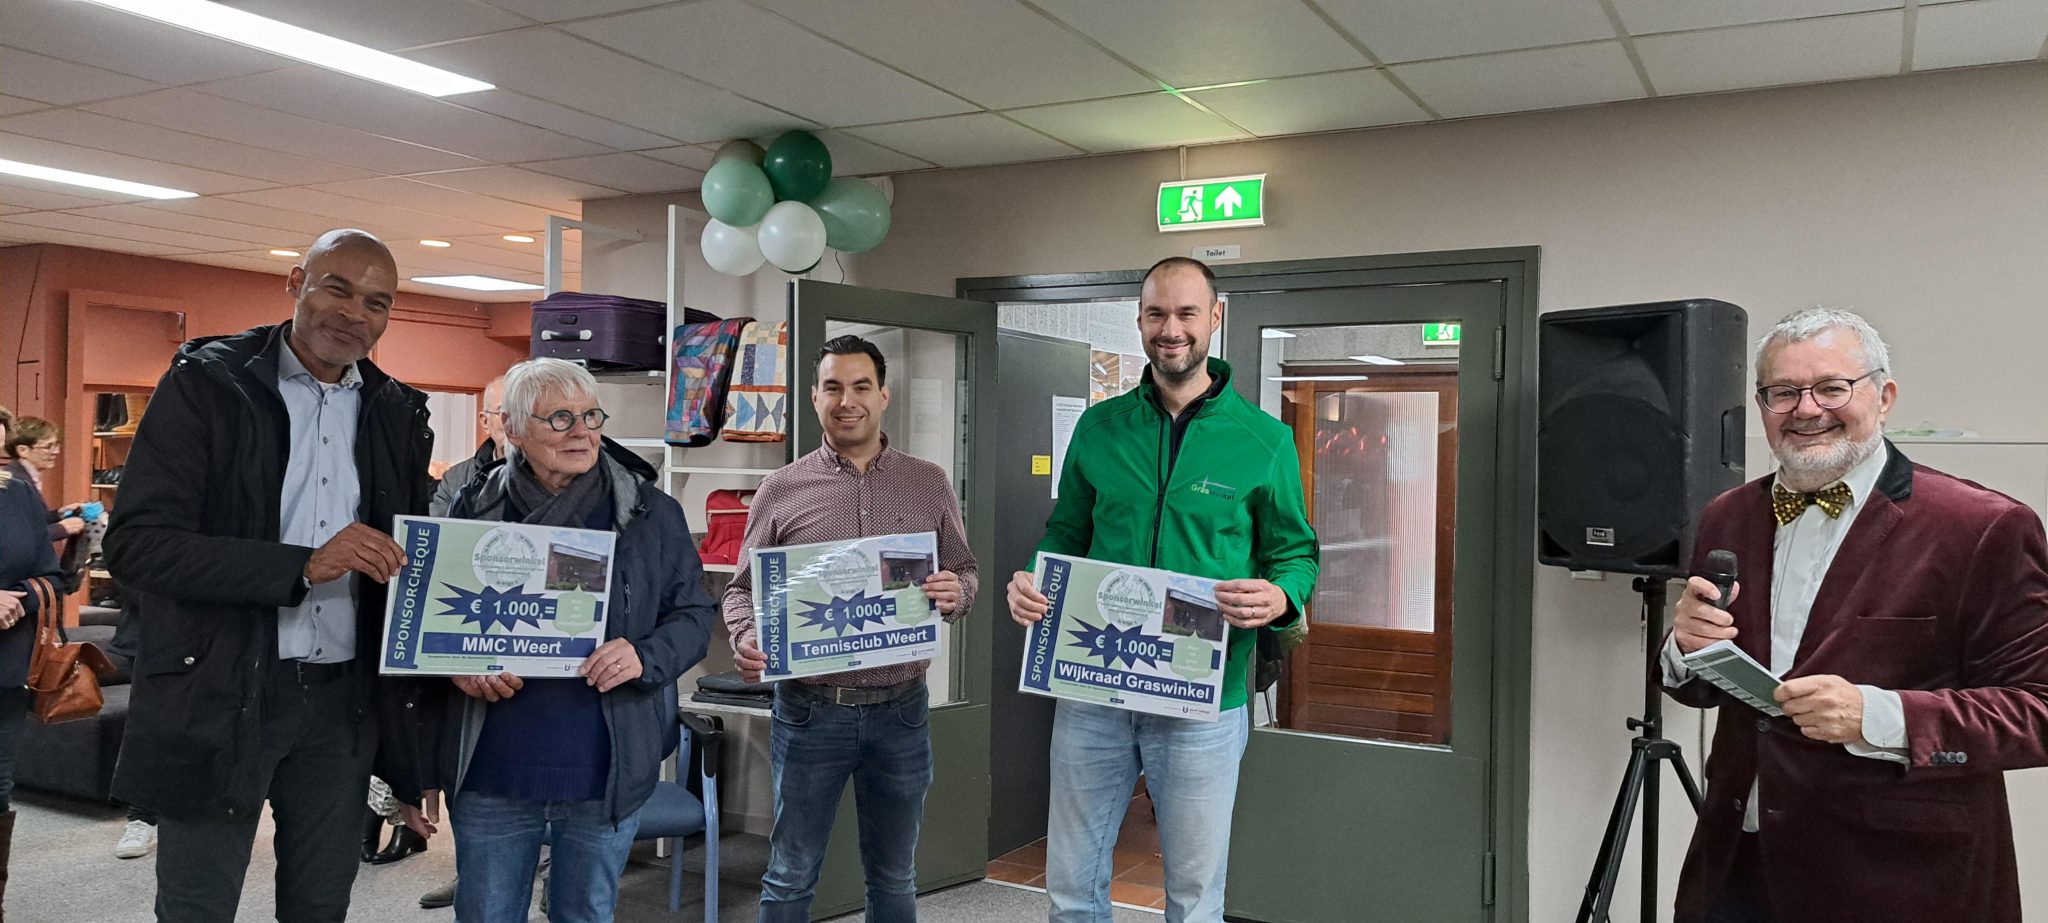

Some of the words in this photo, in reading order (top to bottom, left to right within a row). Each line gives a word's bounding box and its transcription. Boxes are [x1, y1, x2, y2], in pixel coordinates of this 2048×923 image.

[1206, 249, 1226, 257] Toilet
[474, 553, 546, 566] Sponsorwinkel
[394, 527, 431, 661] SPONSORCHEQUE
[1098, 591, 1162, 609] Sponsorwinkel
[470, 599, 482, 614] €
[493, 601, 556, 619] 1.000,=
[769, 557, 780, 669] SPONSORCHEQUE
[824, 608, 835, 621] €
[843, 603, 895, 620] 1.000,=
[1031, 564, 1064, 682] SPONSORCHEQUE
[462, 636, 508, 653] MMC
[512, 639, 562, 654] Weert
[801, 636, 883, 657] Tennisclub
[885, 629, 928, 646] Weert
[1094, 634, 1105, 649] €
[1115, 638, 1172, 660] 1.000,=
[1058, 662, 1122, 686] Wijkraad
[1126, 674, 1211, 700] Graswinkel
